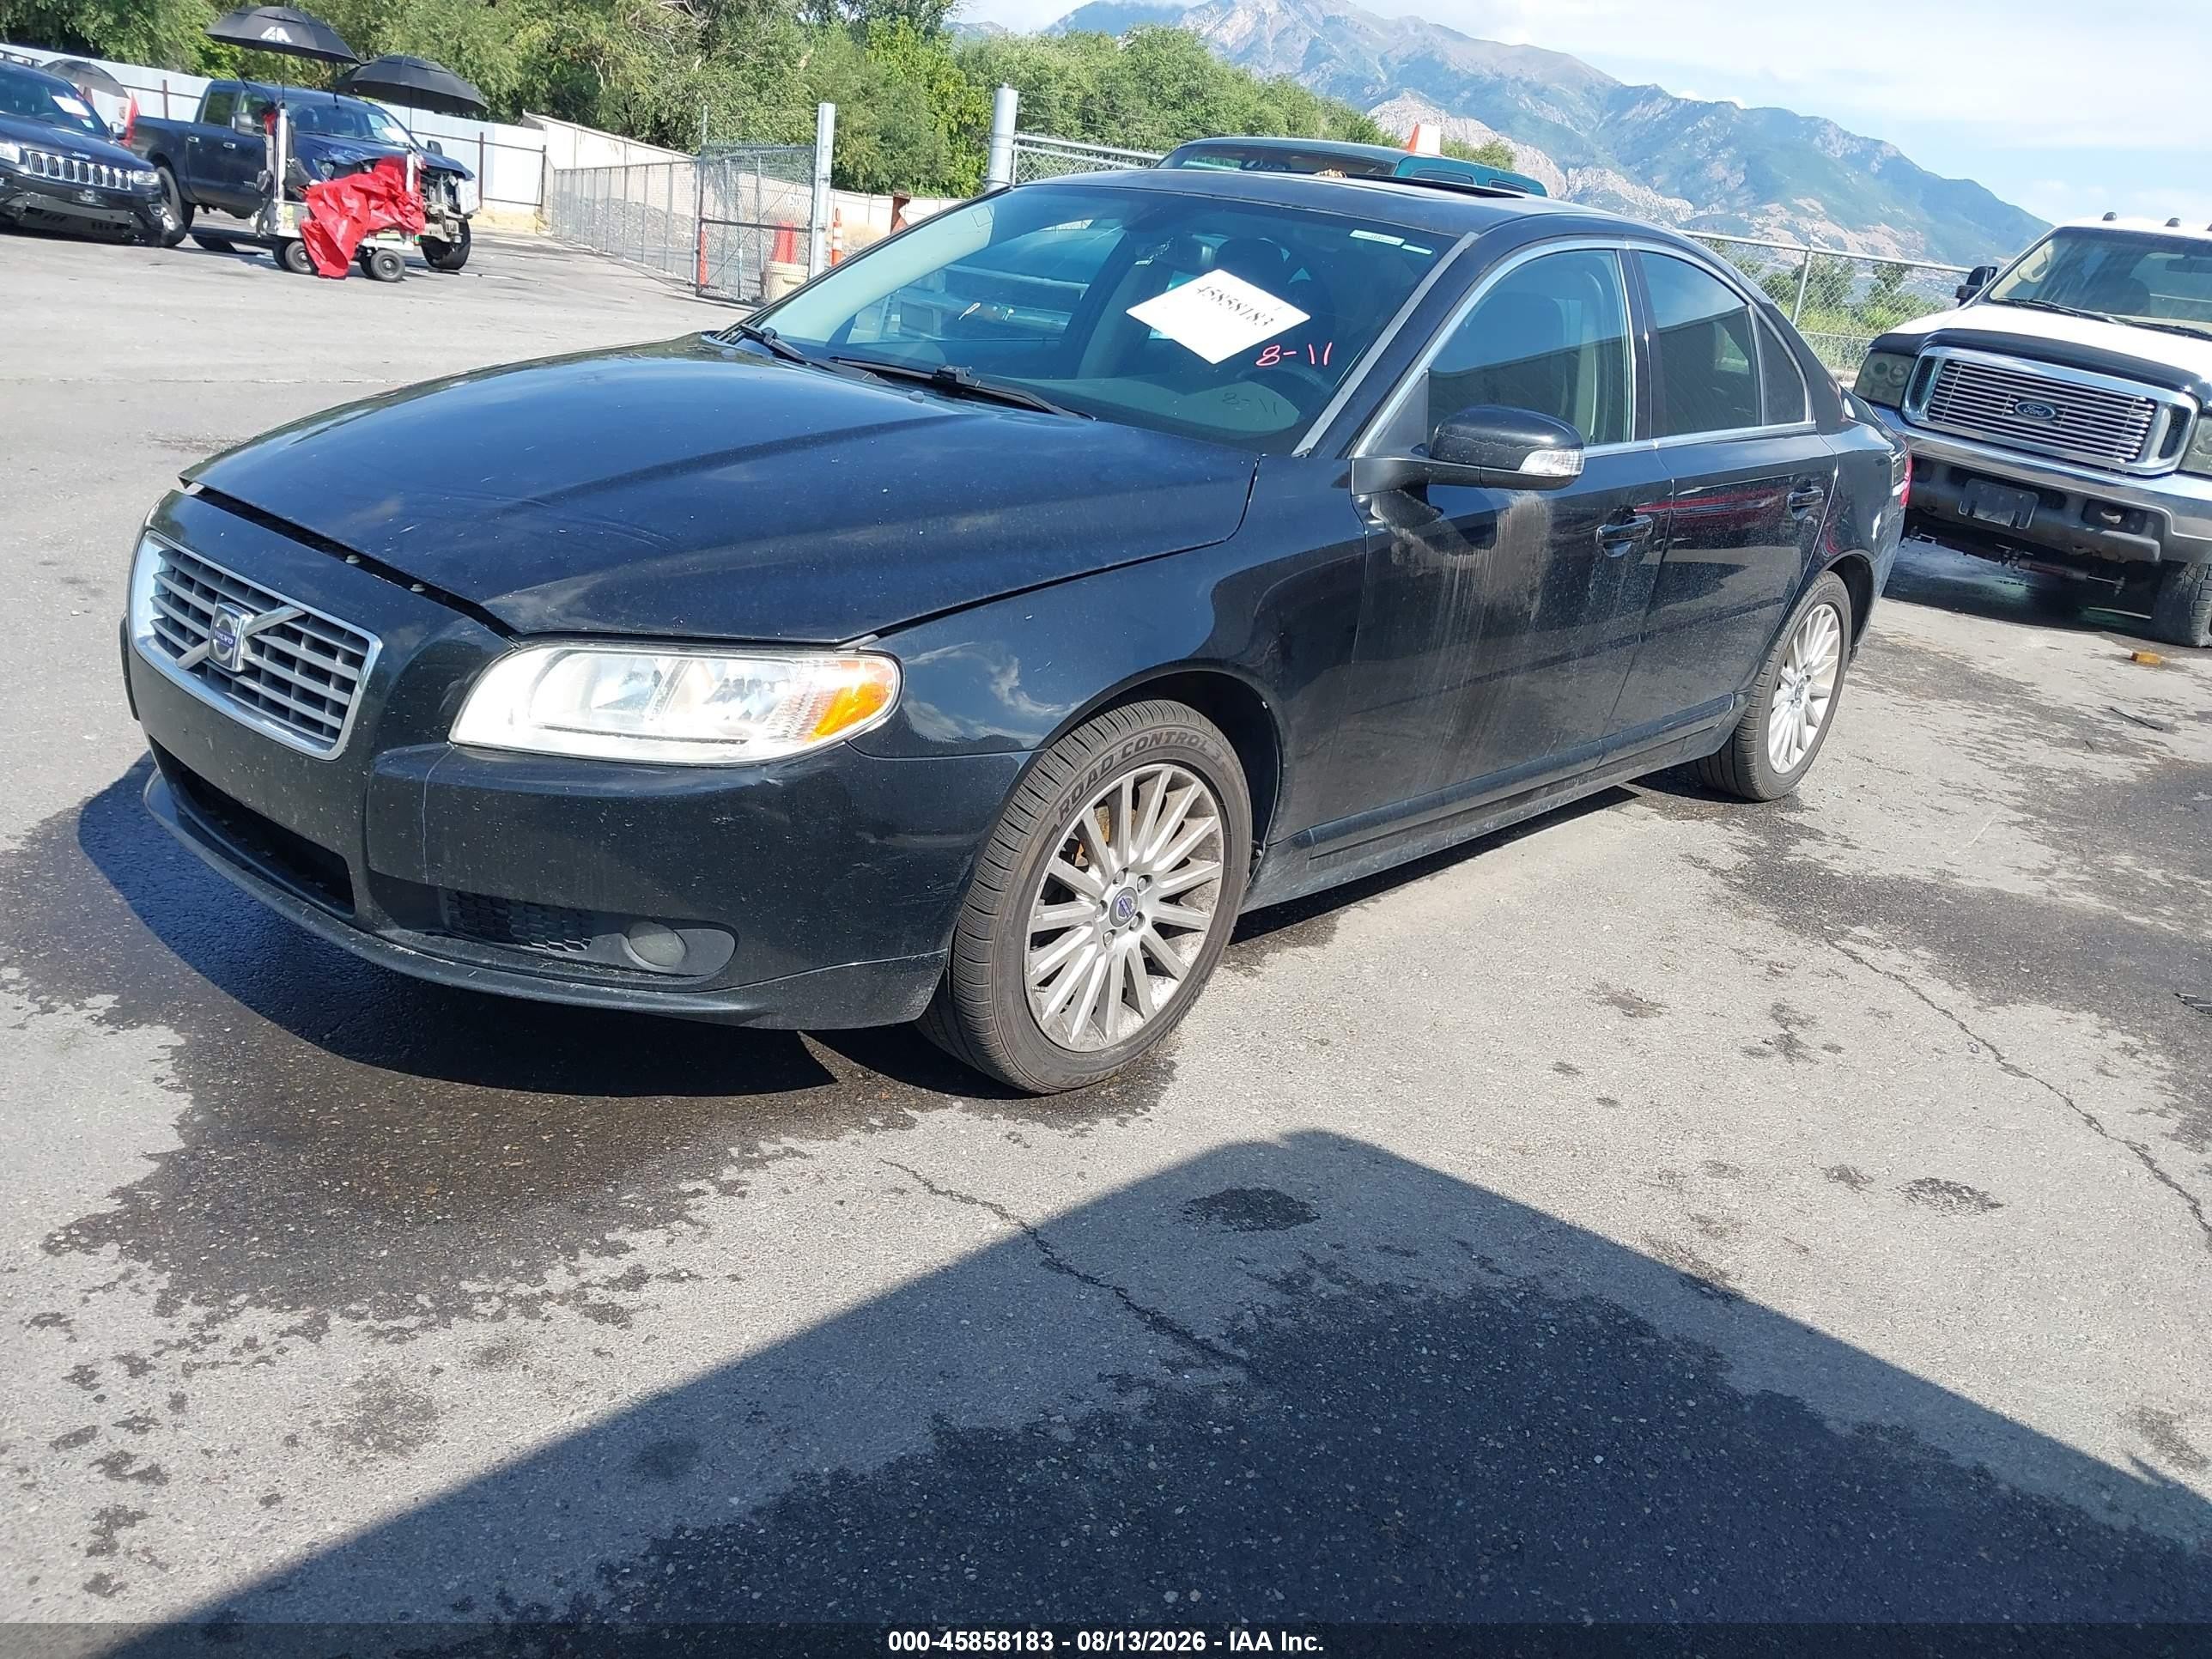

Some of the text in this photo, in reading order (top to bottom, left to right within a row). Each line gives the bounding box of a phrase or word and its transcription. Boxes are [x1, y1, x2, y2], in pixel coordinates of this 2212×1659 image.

[1255, 342, 1333, 366] 8-11
[2023, 404, 2047, 416] Ford
[1058, 754, 1115, 822] ROAD
[1121, 731, 1208, 759] CONTROL
